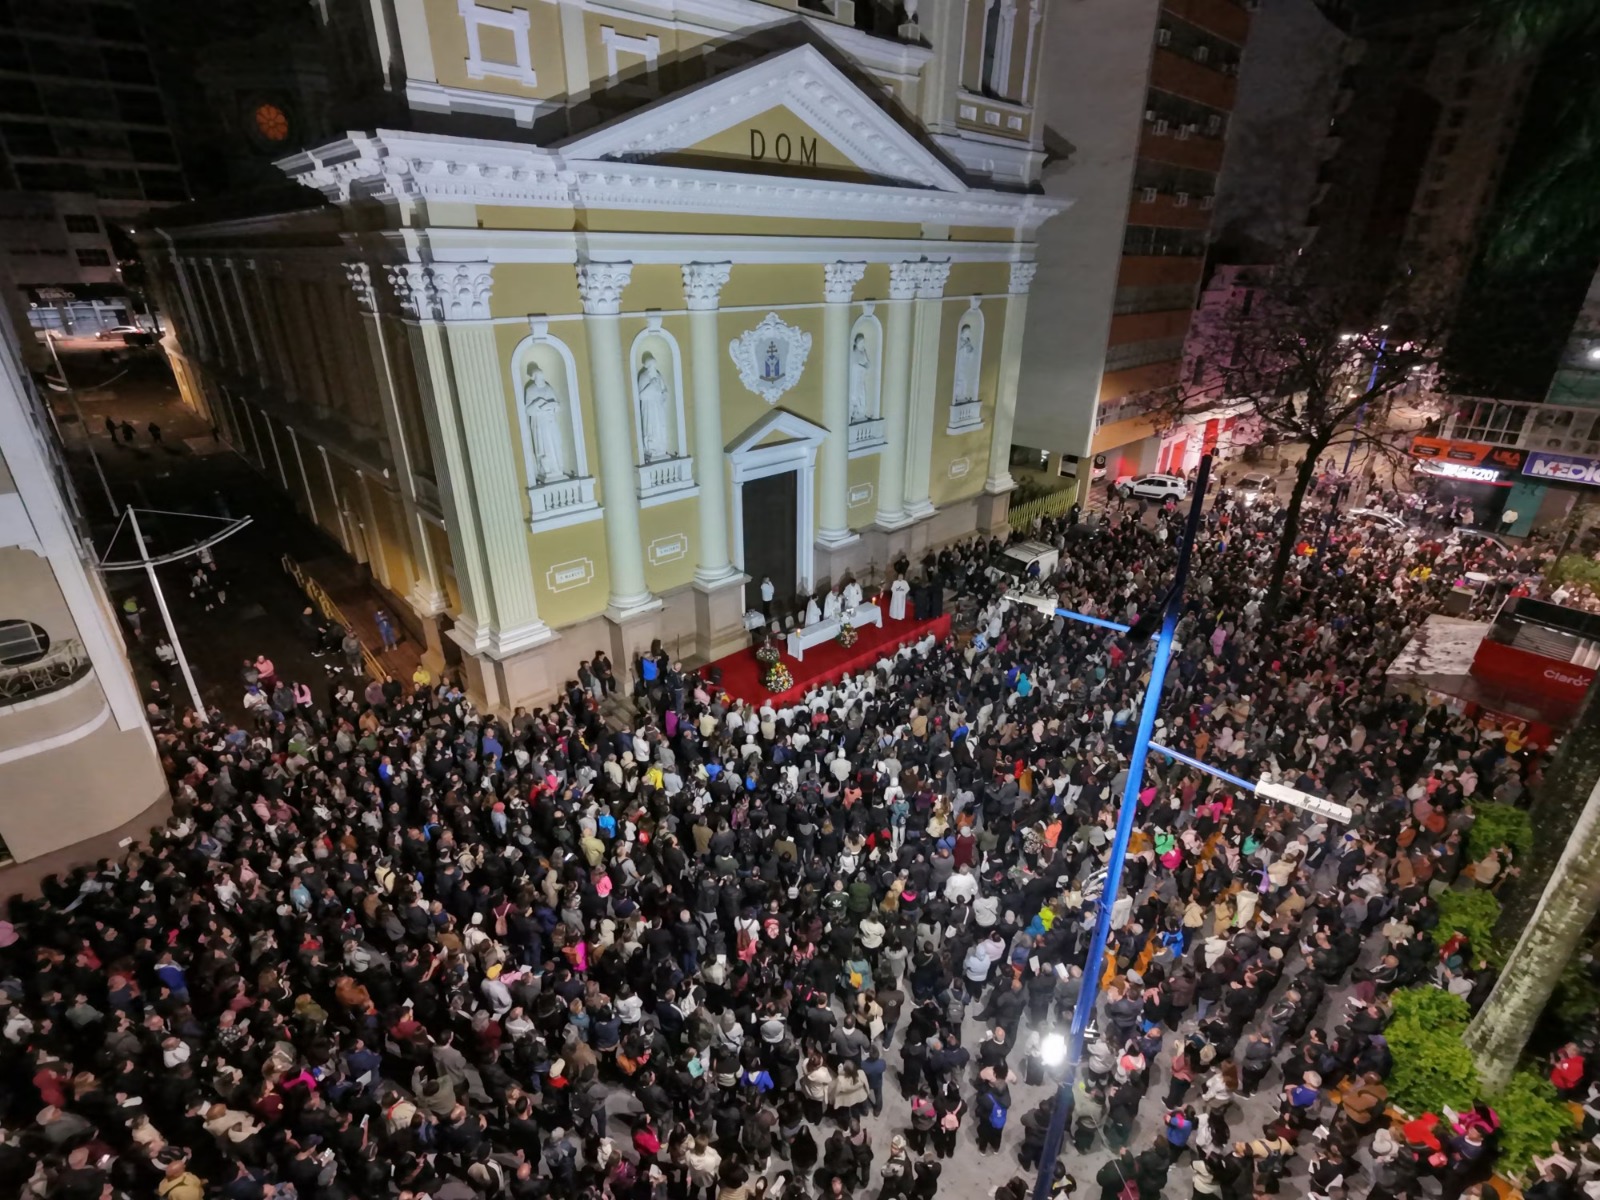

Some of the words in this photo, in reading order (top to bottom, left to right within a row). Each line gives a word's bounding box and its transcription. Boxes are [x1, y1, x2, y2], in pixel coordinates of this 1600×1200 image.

[750, 129, 817, 167] DOM
[1443, 462, 1499, 482] GAZZO!
[1543, 669, 1587, 687] Claro
